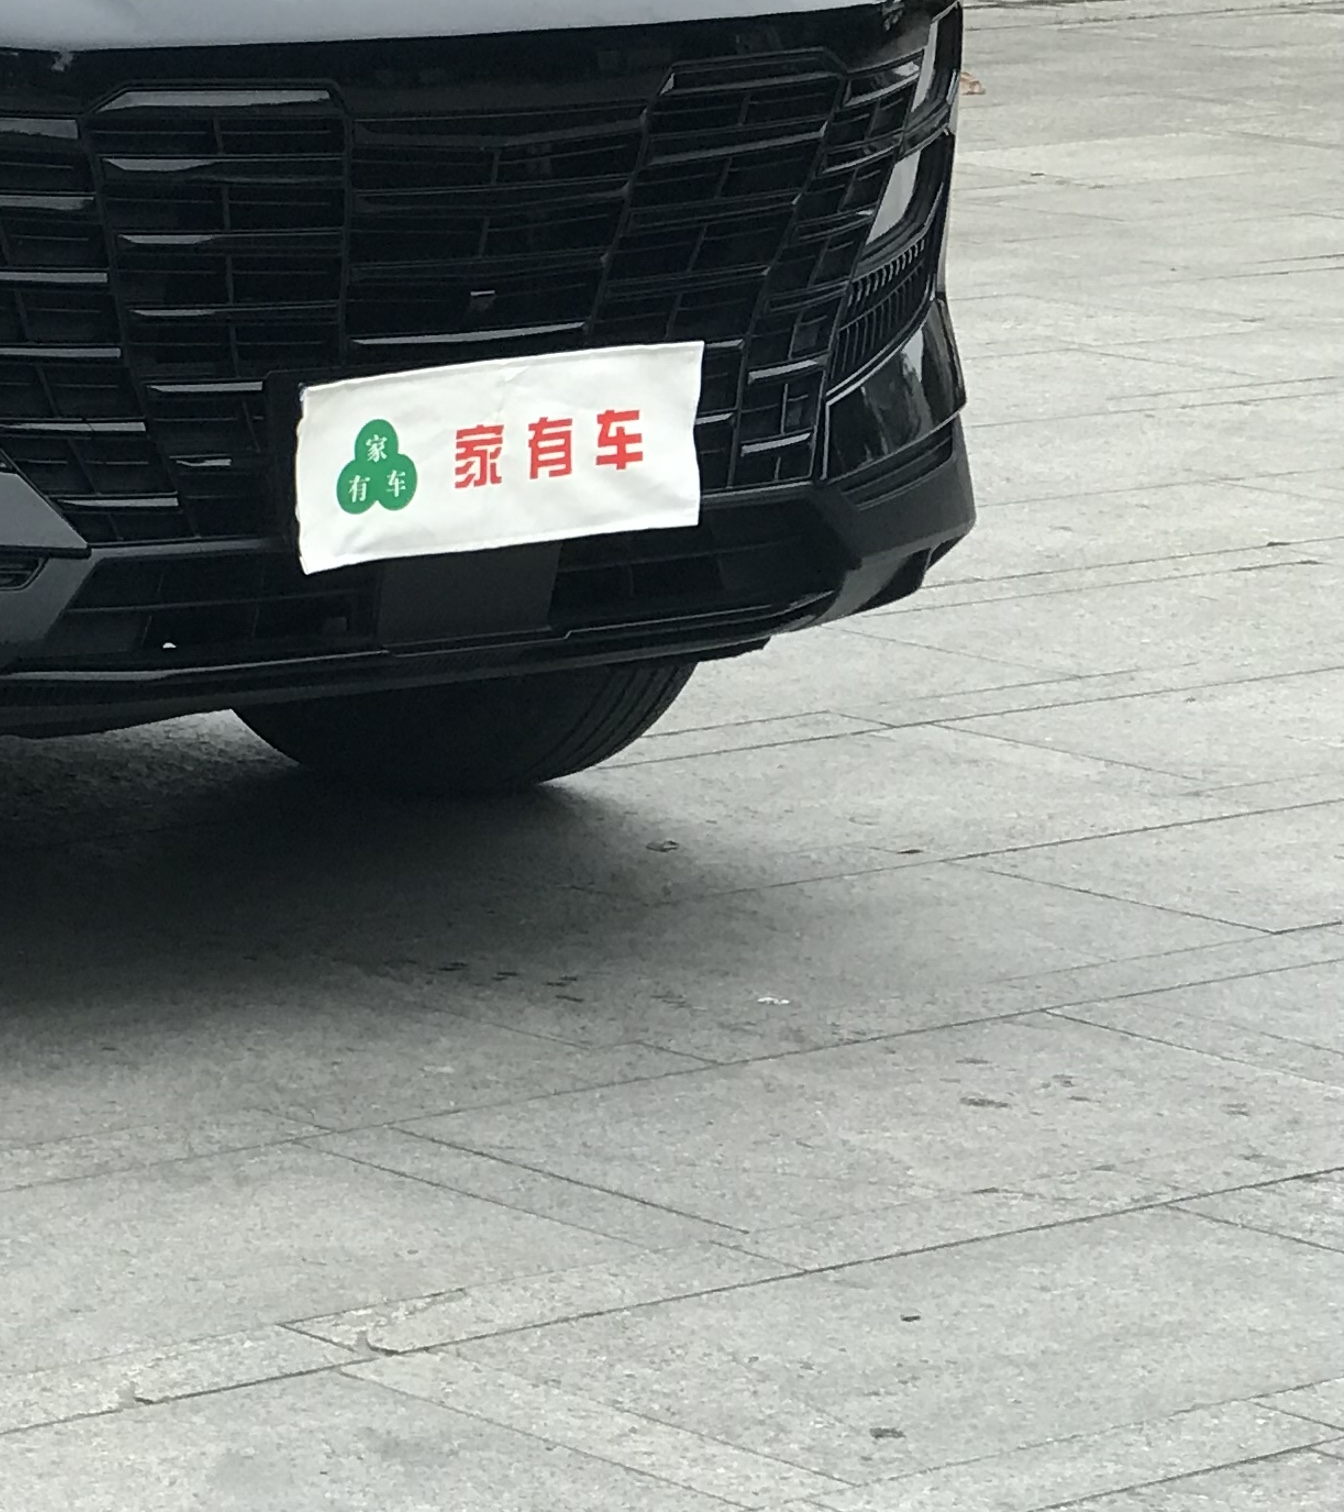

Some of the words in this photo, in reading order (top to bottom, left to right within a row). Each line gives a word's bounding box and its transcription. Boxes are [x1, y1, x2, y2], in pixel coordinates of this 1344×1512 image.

[365, 433, 389, 463] 家
[454, 408, 644, 490] 家有车
